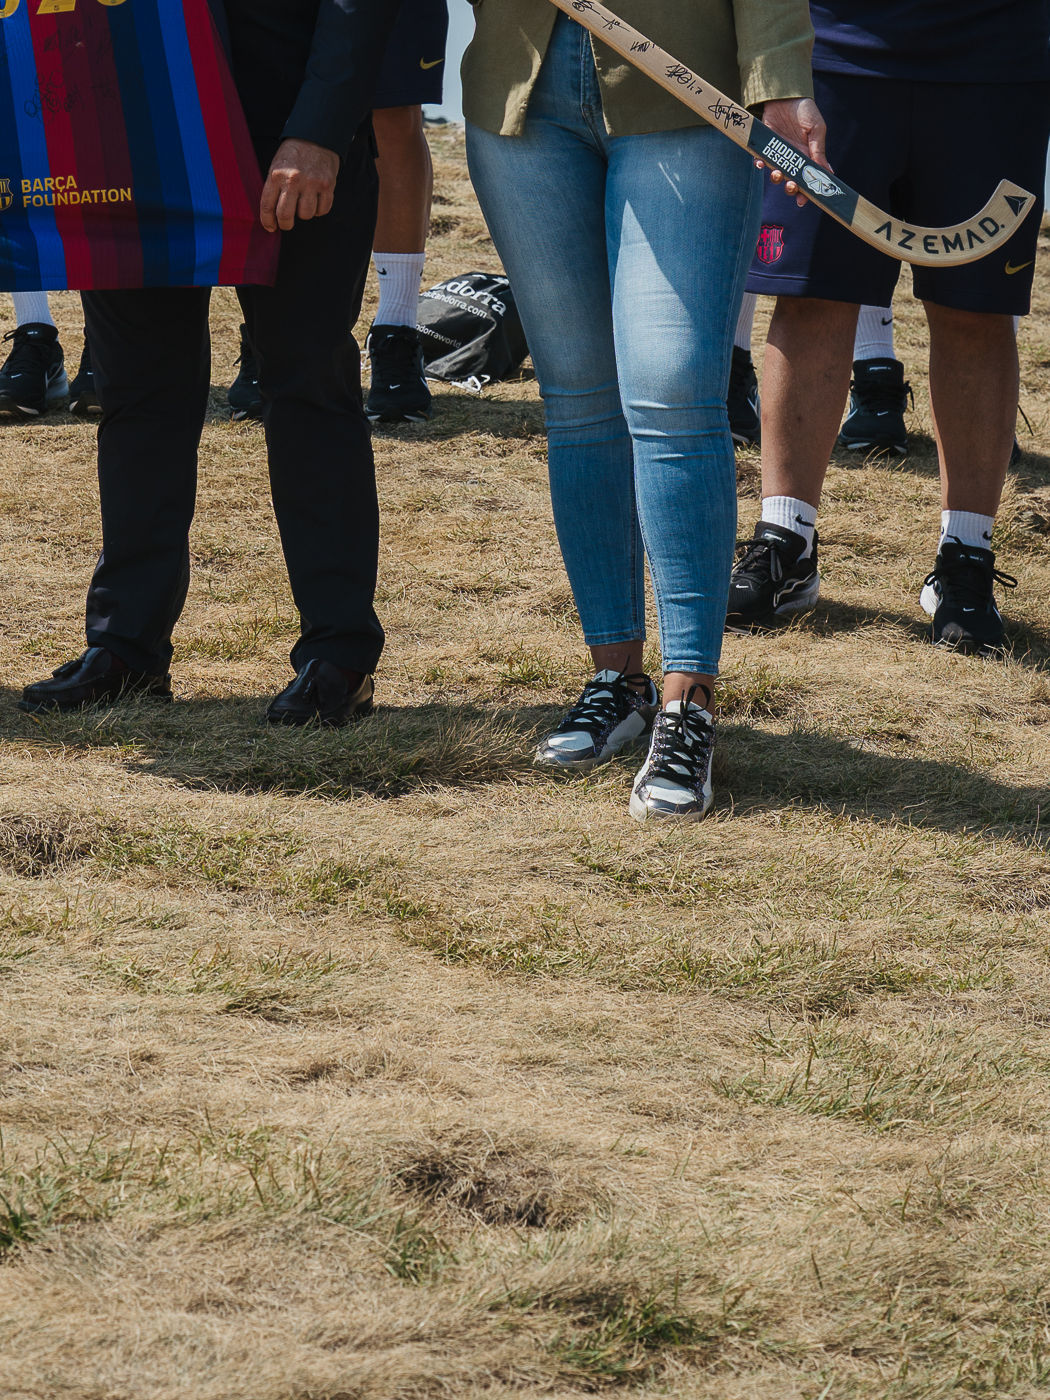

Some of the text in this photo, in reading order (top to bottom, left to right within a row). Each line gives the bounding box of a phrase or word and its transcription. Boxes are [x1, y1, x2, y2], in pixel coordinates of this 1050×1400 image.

[762, 145, 800, 177] DESERTS
[767, 136, 806, 169] HIDDEN
[21, 175, 78, 193] BARÇA
[22, 187, 132, 209] FOUNDATION
[429, 280, 507, 317] dorra
